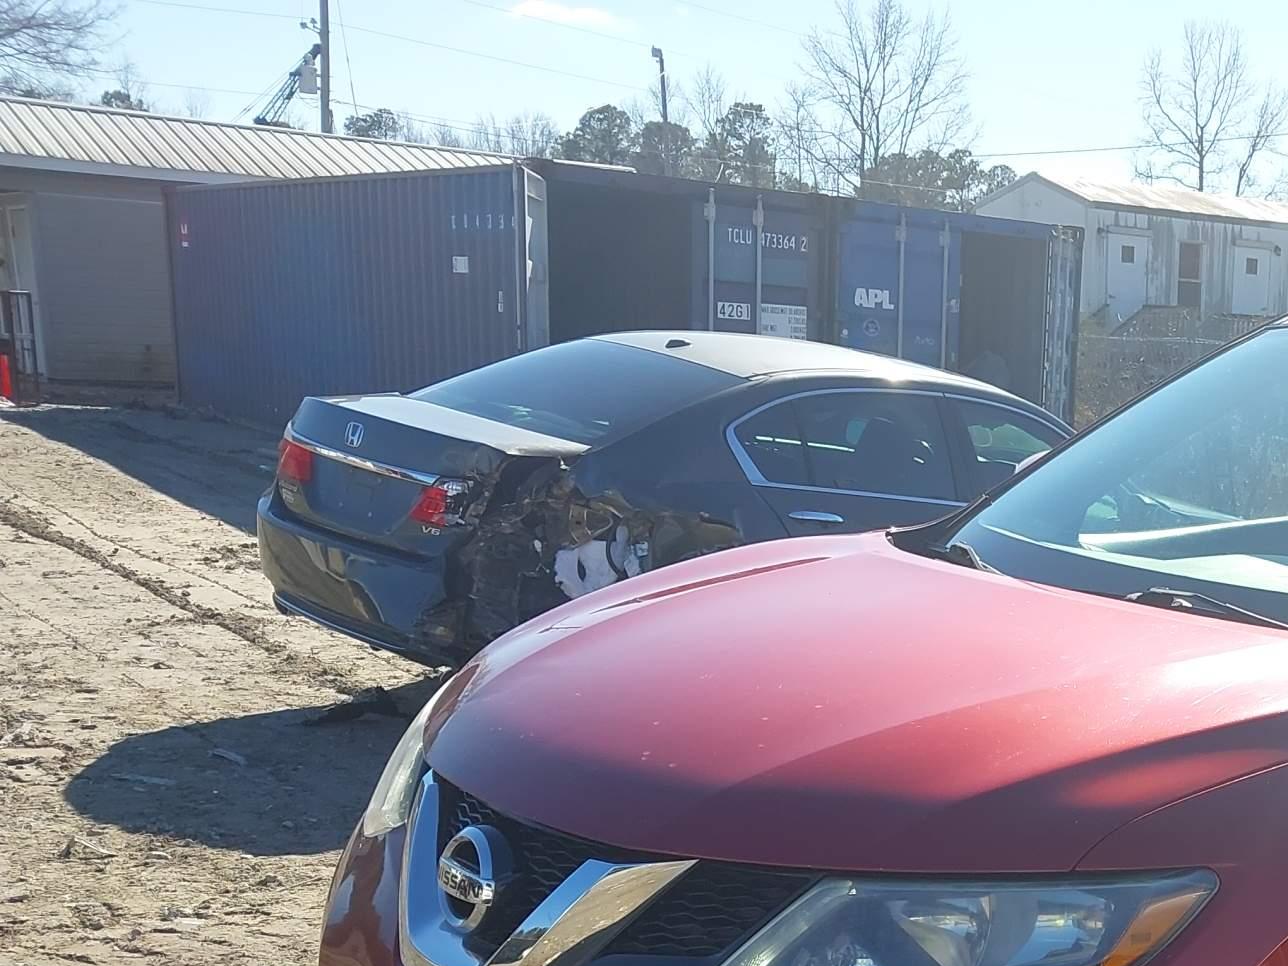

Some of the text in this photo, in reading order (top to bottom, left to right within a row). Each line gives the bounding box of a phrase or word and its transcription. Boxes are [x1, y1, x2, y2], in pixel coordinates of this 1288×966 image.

[728, 228, 752, 244] TCLU
[854, 287, 895, 310] APL
[422, 525, 440, 535] V6
